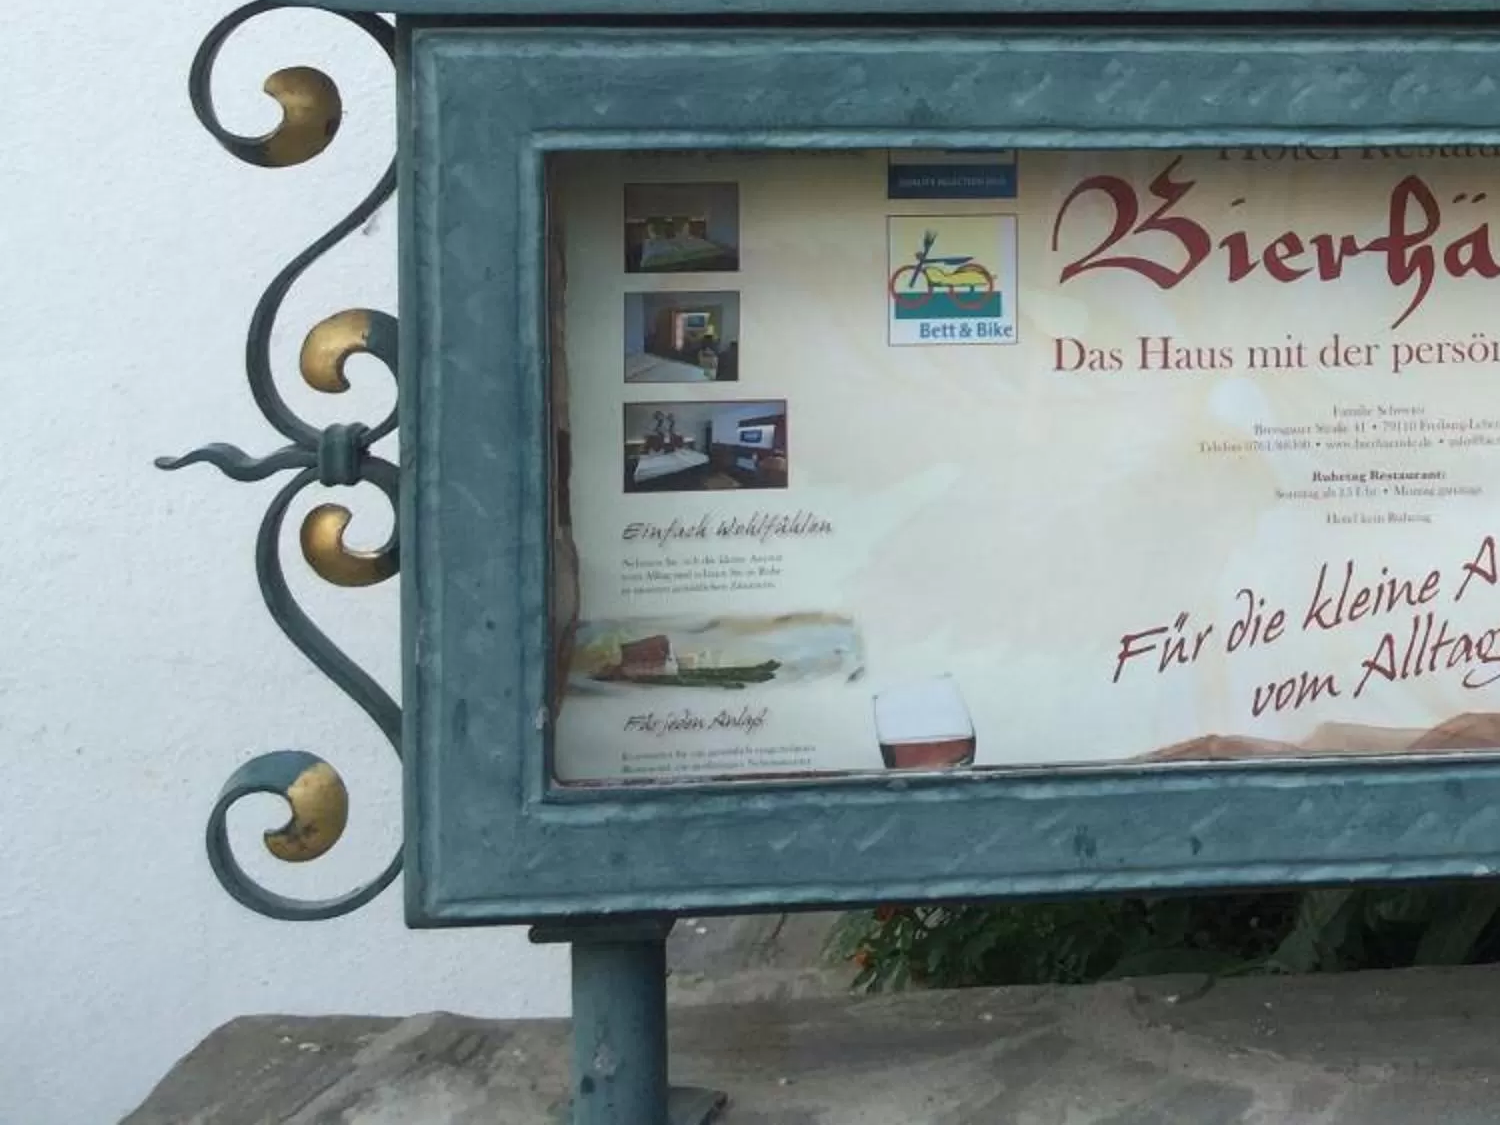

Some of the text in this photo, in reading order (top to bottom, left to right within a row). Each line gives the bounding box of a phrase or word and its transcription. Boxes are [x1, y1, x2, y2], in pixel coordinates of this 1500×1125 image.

[920, 321, 1013, 338] Bett & Bike
[1054, 336, 1123, 372] Das
[1137, 336, 1234, 371] Haus
[1247, 333, 1308, 369] mit
[1319, 332, 1380, 368] der
[1114, 612, 1213, 683] Für
[1226, 589, 1286, 654] die
[1302, 561, 1441, 630] kleine
[1251, 670, 1341, 718] vom
